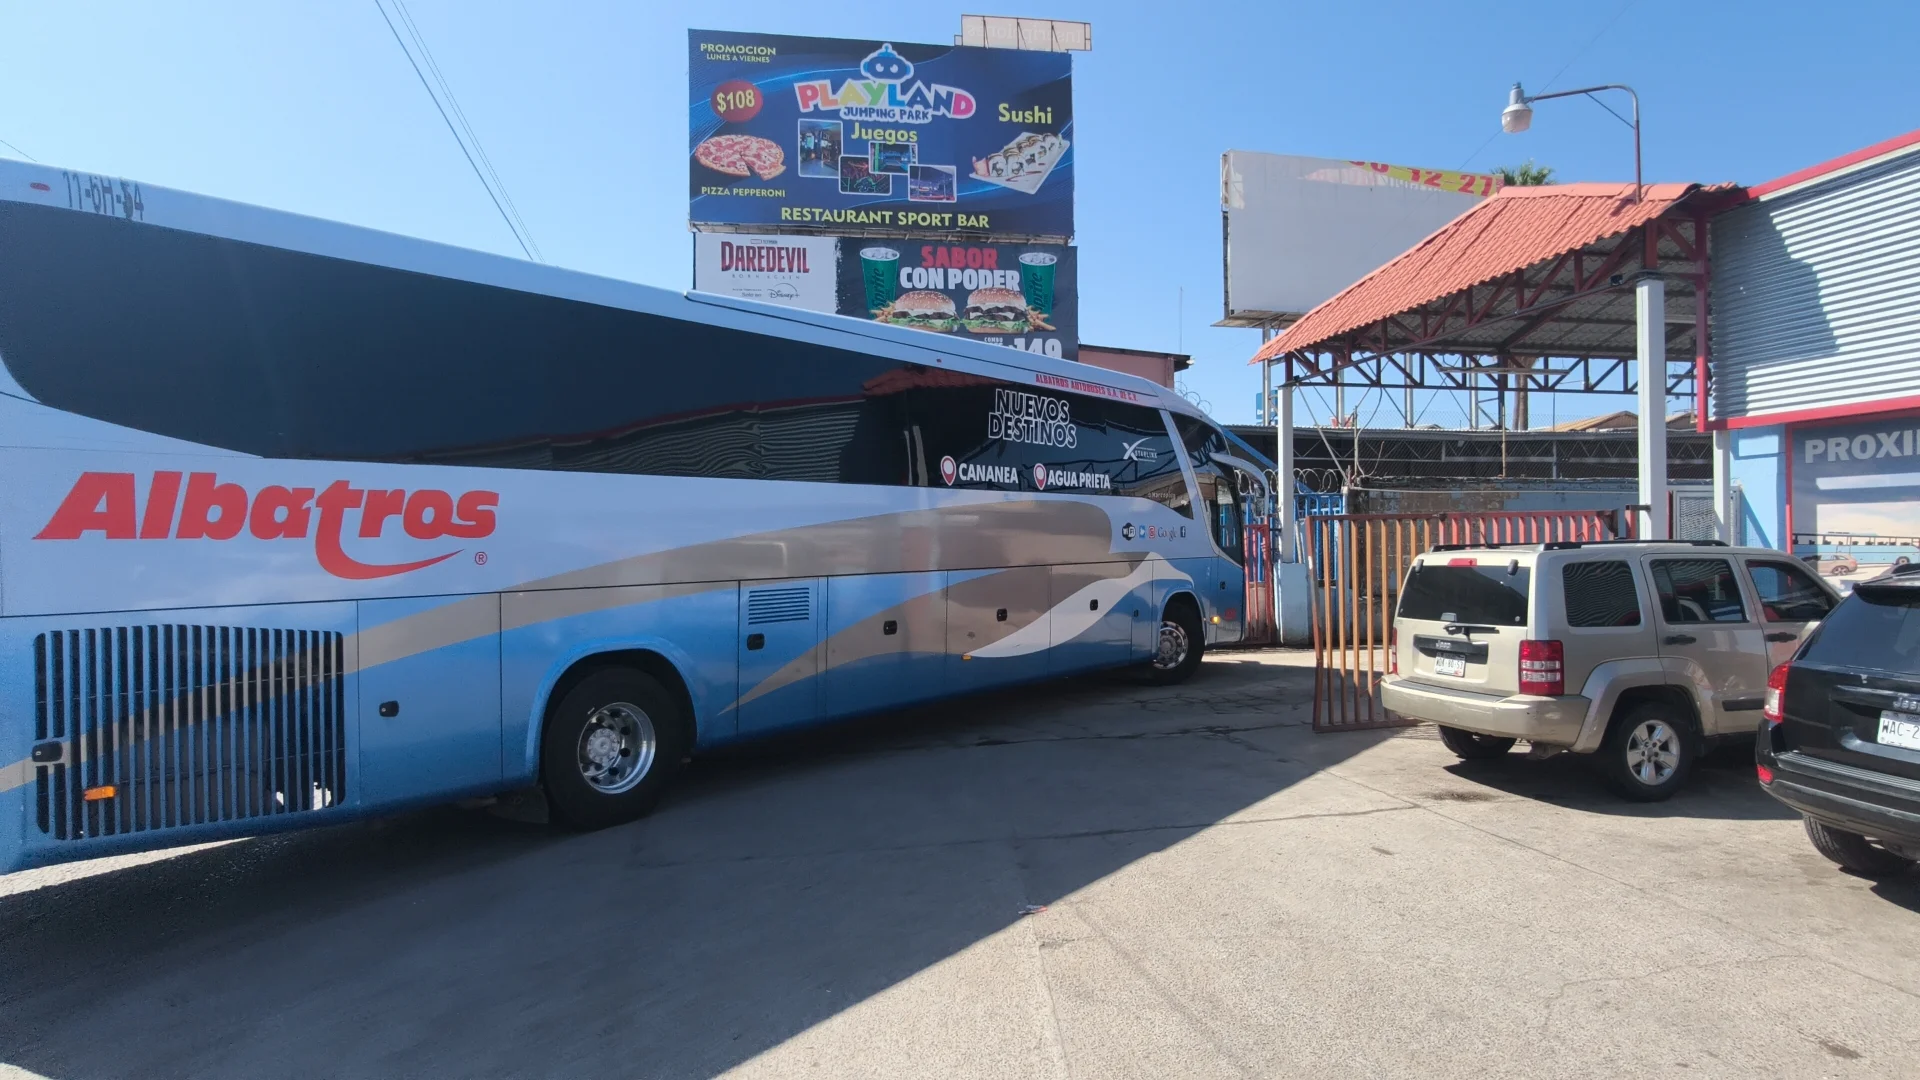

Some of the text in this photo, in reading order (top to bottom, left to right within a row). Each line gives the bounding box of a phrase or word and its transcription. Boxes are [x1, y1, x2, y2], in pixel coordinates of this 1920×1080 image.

[700, 43, 776, 55] PROMOCION
[706, 53, 730, 61] LUNES
[739, 55, 770, 63] VIERNES
[716, 89, 755, 113] $108
[796, 81, 975, 117] PLAYLAND
[843, 106, 930, 121] JUMPING PARK
[998, 103, 1052, 124] Sushi
[851, 122, 917, 145] Juegos
[701, 186, 786, 198] PIZZA PEPPERONI
[781, 207, 989, 229] RESTAURANT SPORT BAR
[720, 241, 810, 273] DAREDEVIL
[921, 245, 998, 269] SABOR
[900, 266, 1020, 291] CON PODER
[1035, 373, 1069, 389] ALBATROS
[995, 388, 1070, 425] NUEVOS
[988, 412, 1077, 449] DESTINOS
[1805, 428, 1920, 464] PROXI
[958, 463, 1019, 484] CANANEA
[1047, 469, 1111, 489] AGUA PRIETA
[31, 470, 500, 580] Albatros
